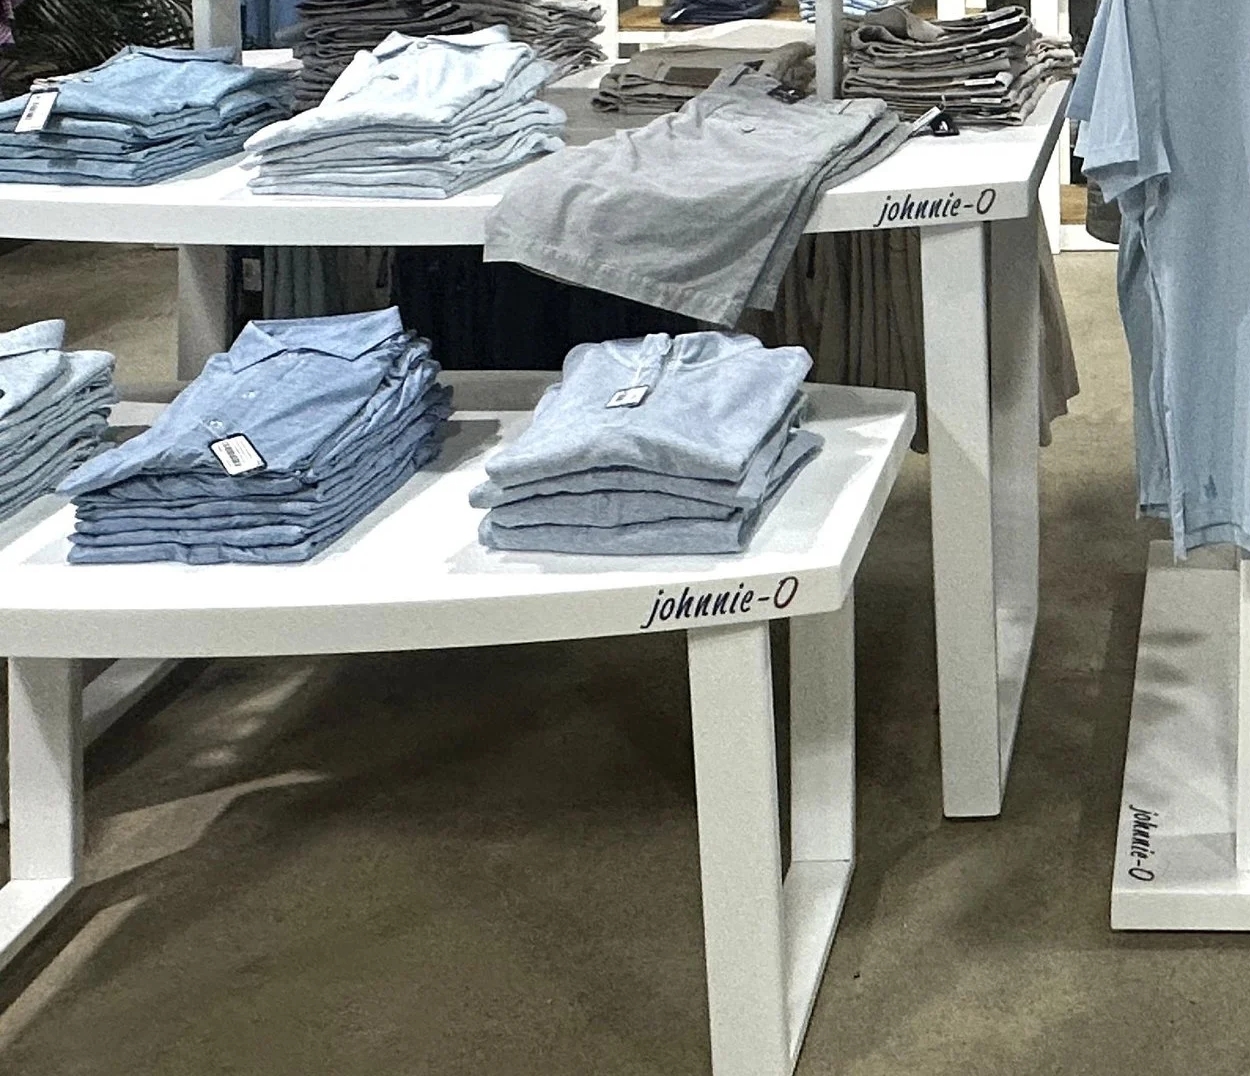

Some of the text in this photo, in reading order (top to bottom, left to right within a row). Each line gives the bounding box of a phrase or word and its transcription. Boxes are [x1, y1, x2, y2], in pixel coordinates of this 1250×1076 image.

[873, 188, 996, 228] johnnie-O
[640, 576, 799, 629] johnnie-O
[1128, 804, 1160, 882] johnnie-O
